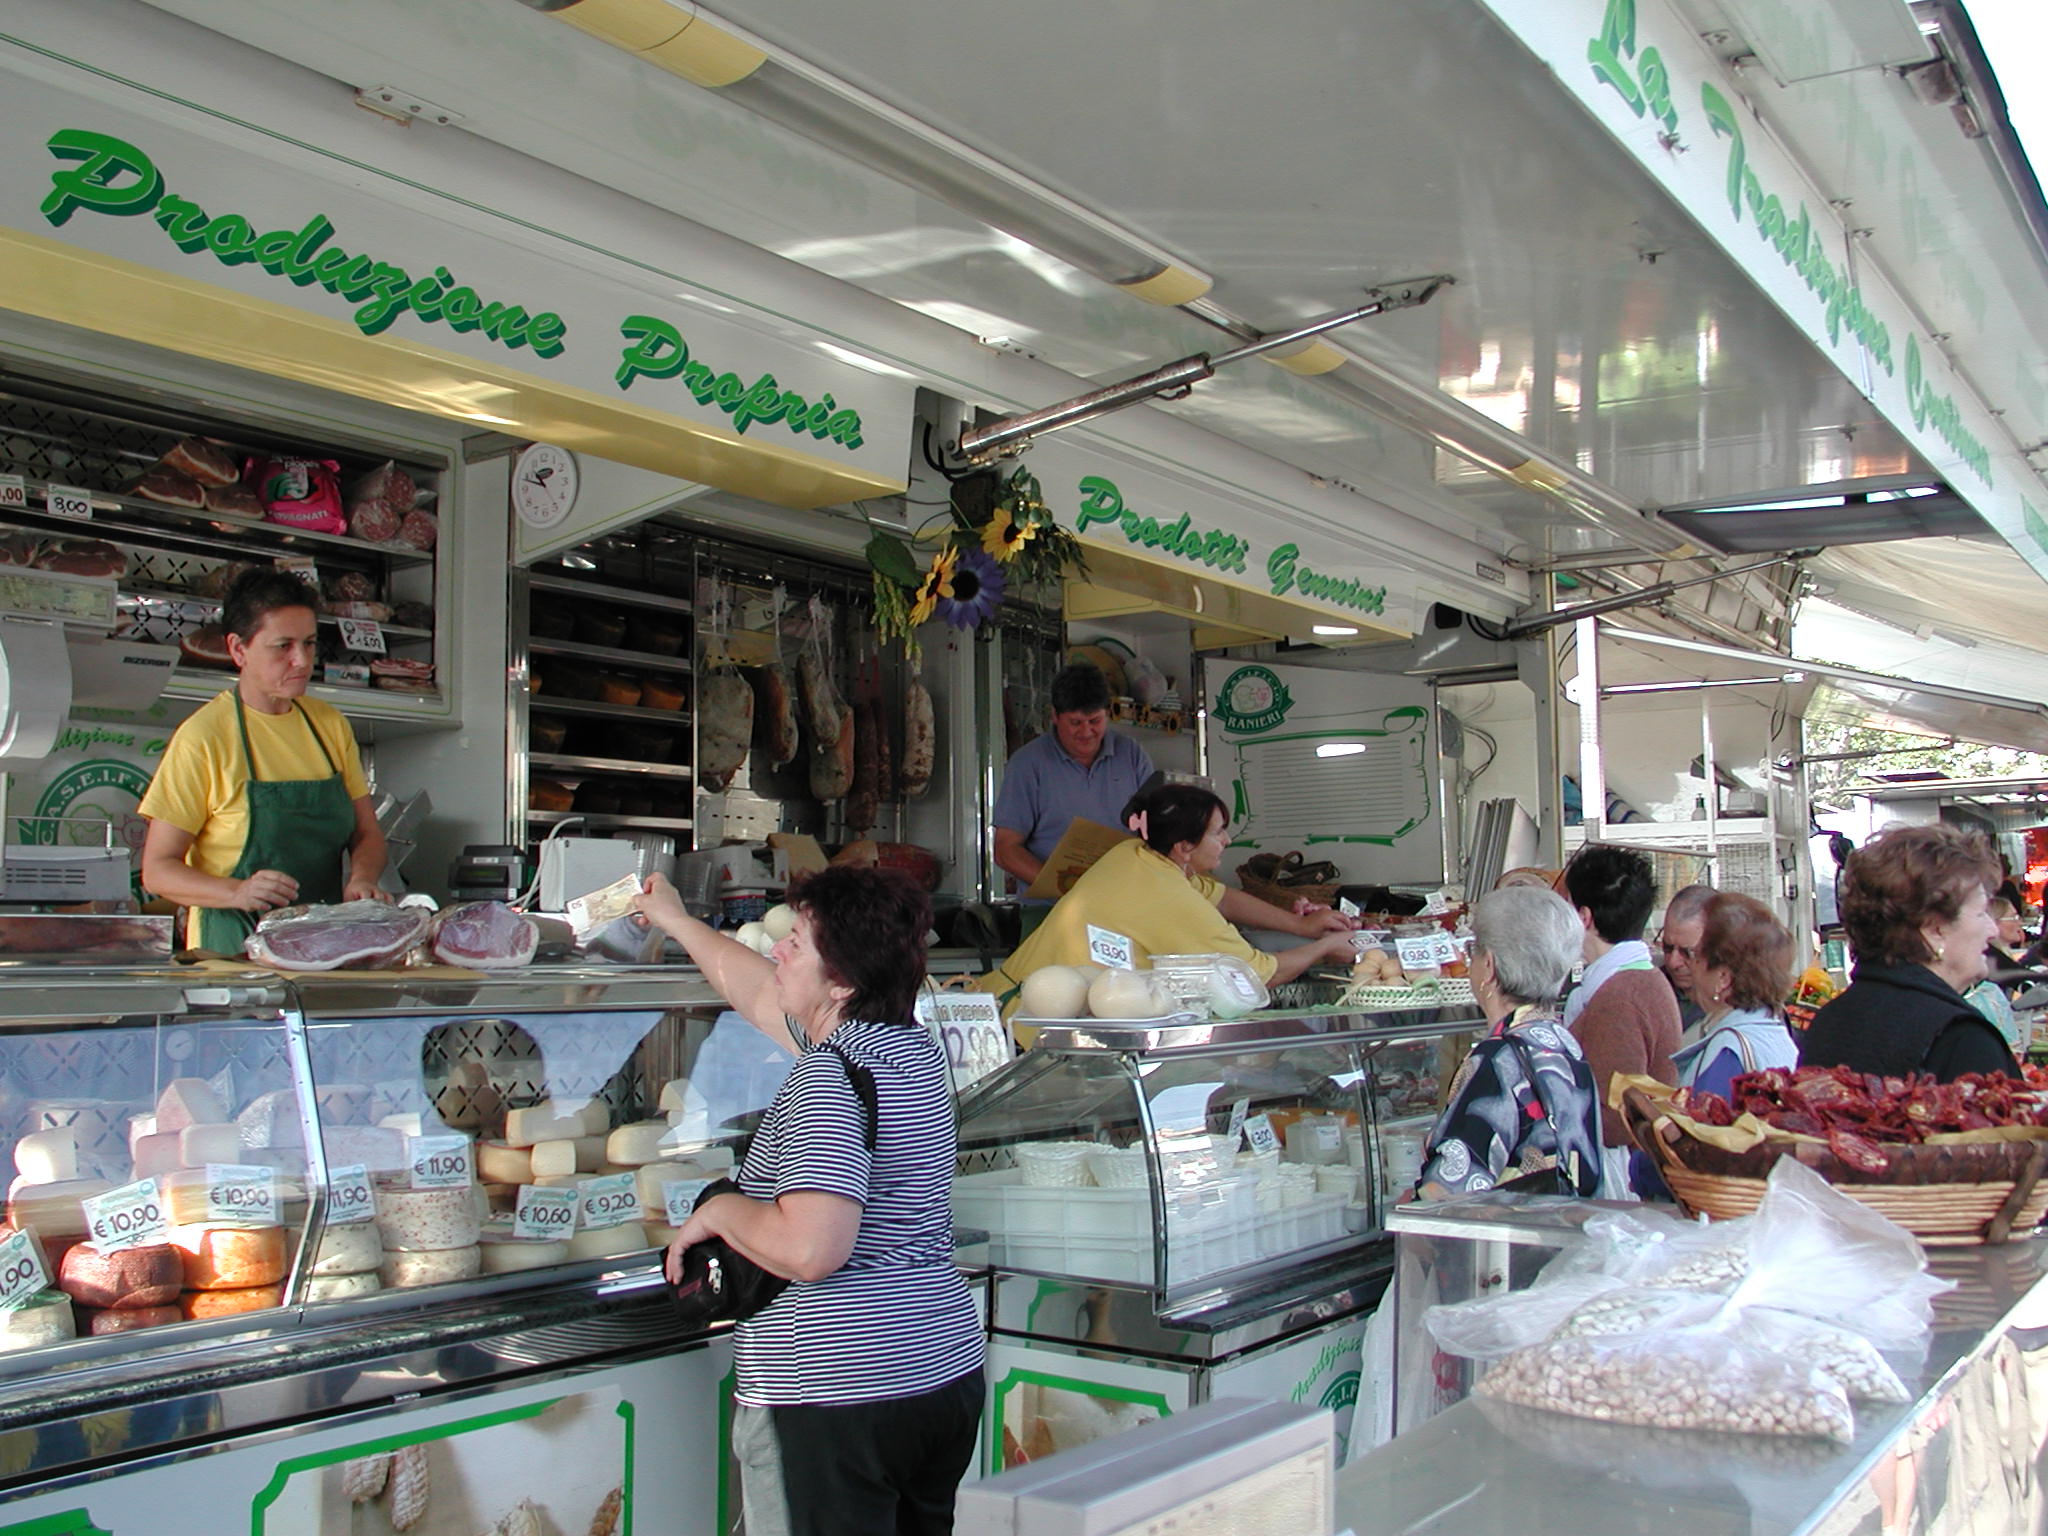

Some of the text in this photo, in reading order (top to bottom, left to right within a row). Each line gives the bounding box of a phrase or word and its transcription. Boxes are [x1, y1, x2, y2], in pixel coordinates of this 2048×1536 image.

[1587, 0, 1678, 133] La
[1701, 81, 1893, 377] Tradizione
[39, 129, 864, 448] Produzione Propria
[0, 487, 23, 503] ,00
[54, 497, 88, 514] 8,00
[1076, 475, 1387, 616] Prodotti Genuini
[1227, 709, 1282, 729] RANIERI
[54, 727, 135, 751] dizione
[1099, 943, 1127, 962] 13,90
[414, 1157, 466, 1177] € 11,90
[210, 1187, 269, 1207] € 10,90
[585, 1192, 636, 1215] € 9,20
[94, 1219, 108, 1238] €
[109, 1204, 159, 1234] 10,90
[519, 1206, 572, 1225] € 10,60
